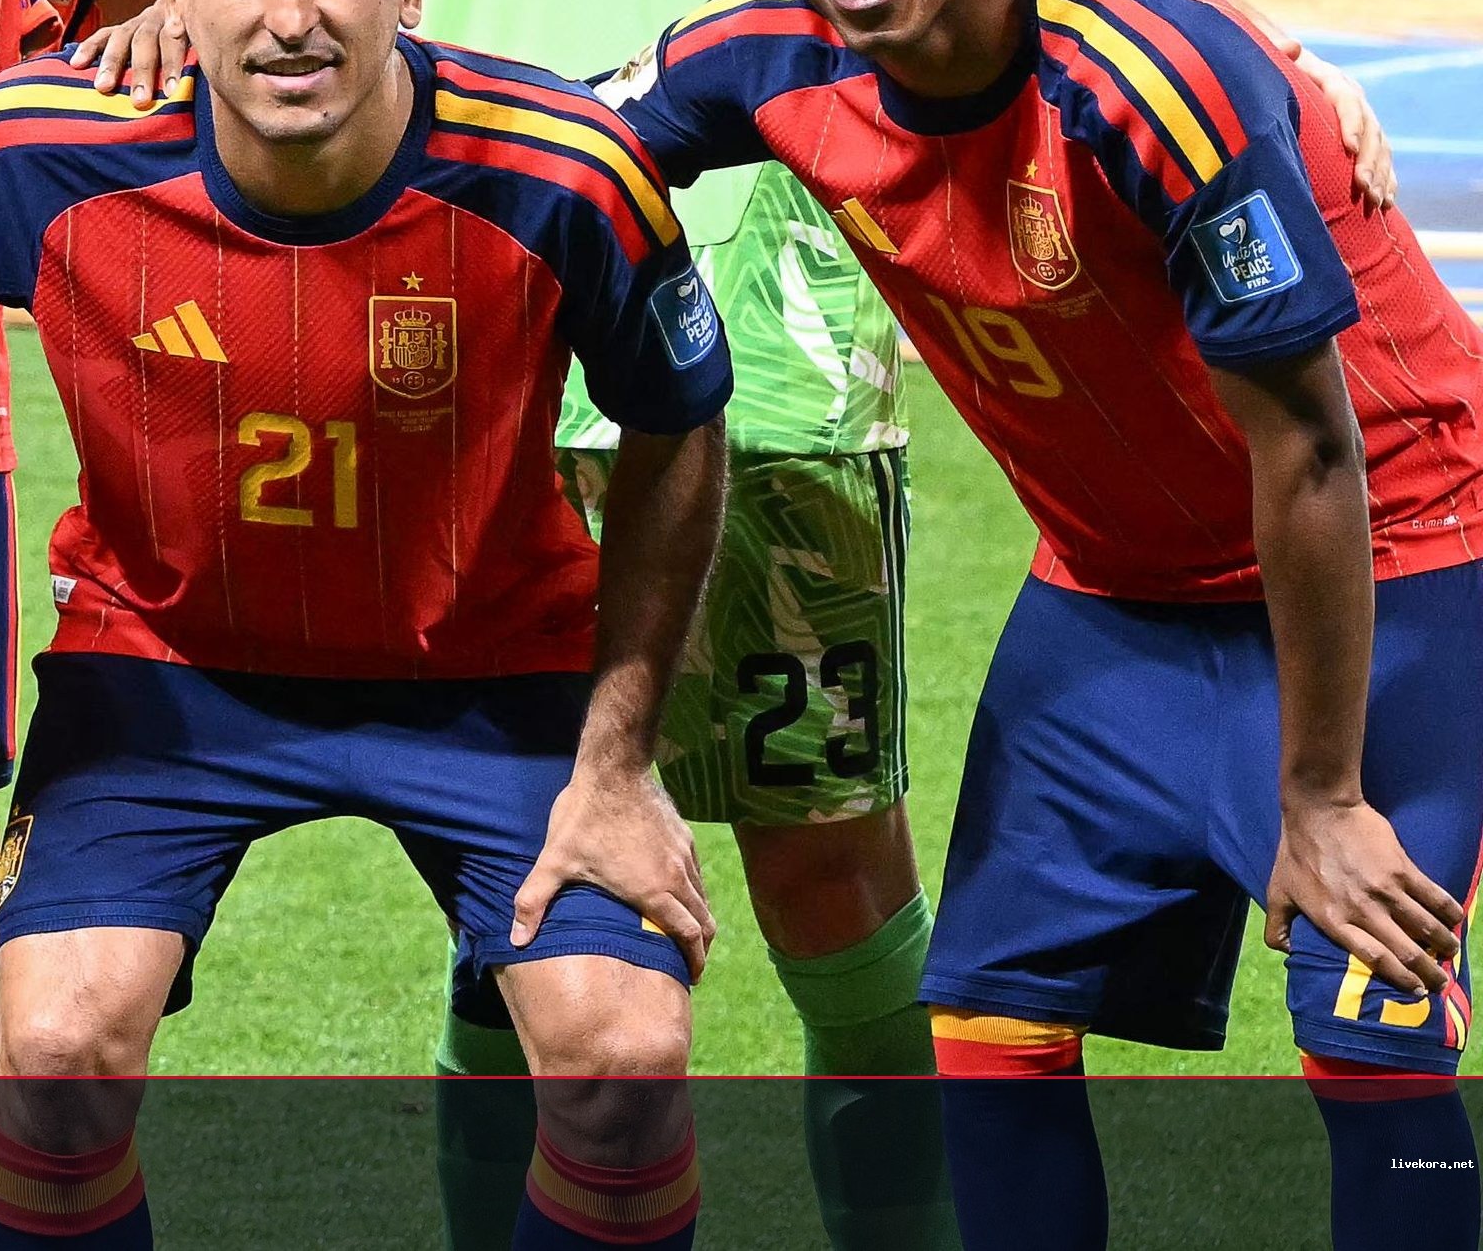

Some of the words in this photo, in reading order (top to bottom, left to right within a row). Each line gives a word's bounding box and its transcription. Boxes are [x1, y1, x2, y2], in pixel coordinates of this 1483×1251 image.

[1230, 255, 1275, 282] PEACE
[1246, 276, 1272, 290] FIFA
[924, 293, 1064, 399] 19
[238, 412, 358, 529] 21
[738, 638, 879, 788] 23
